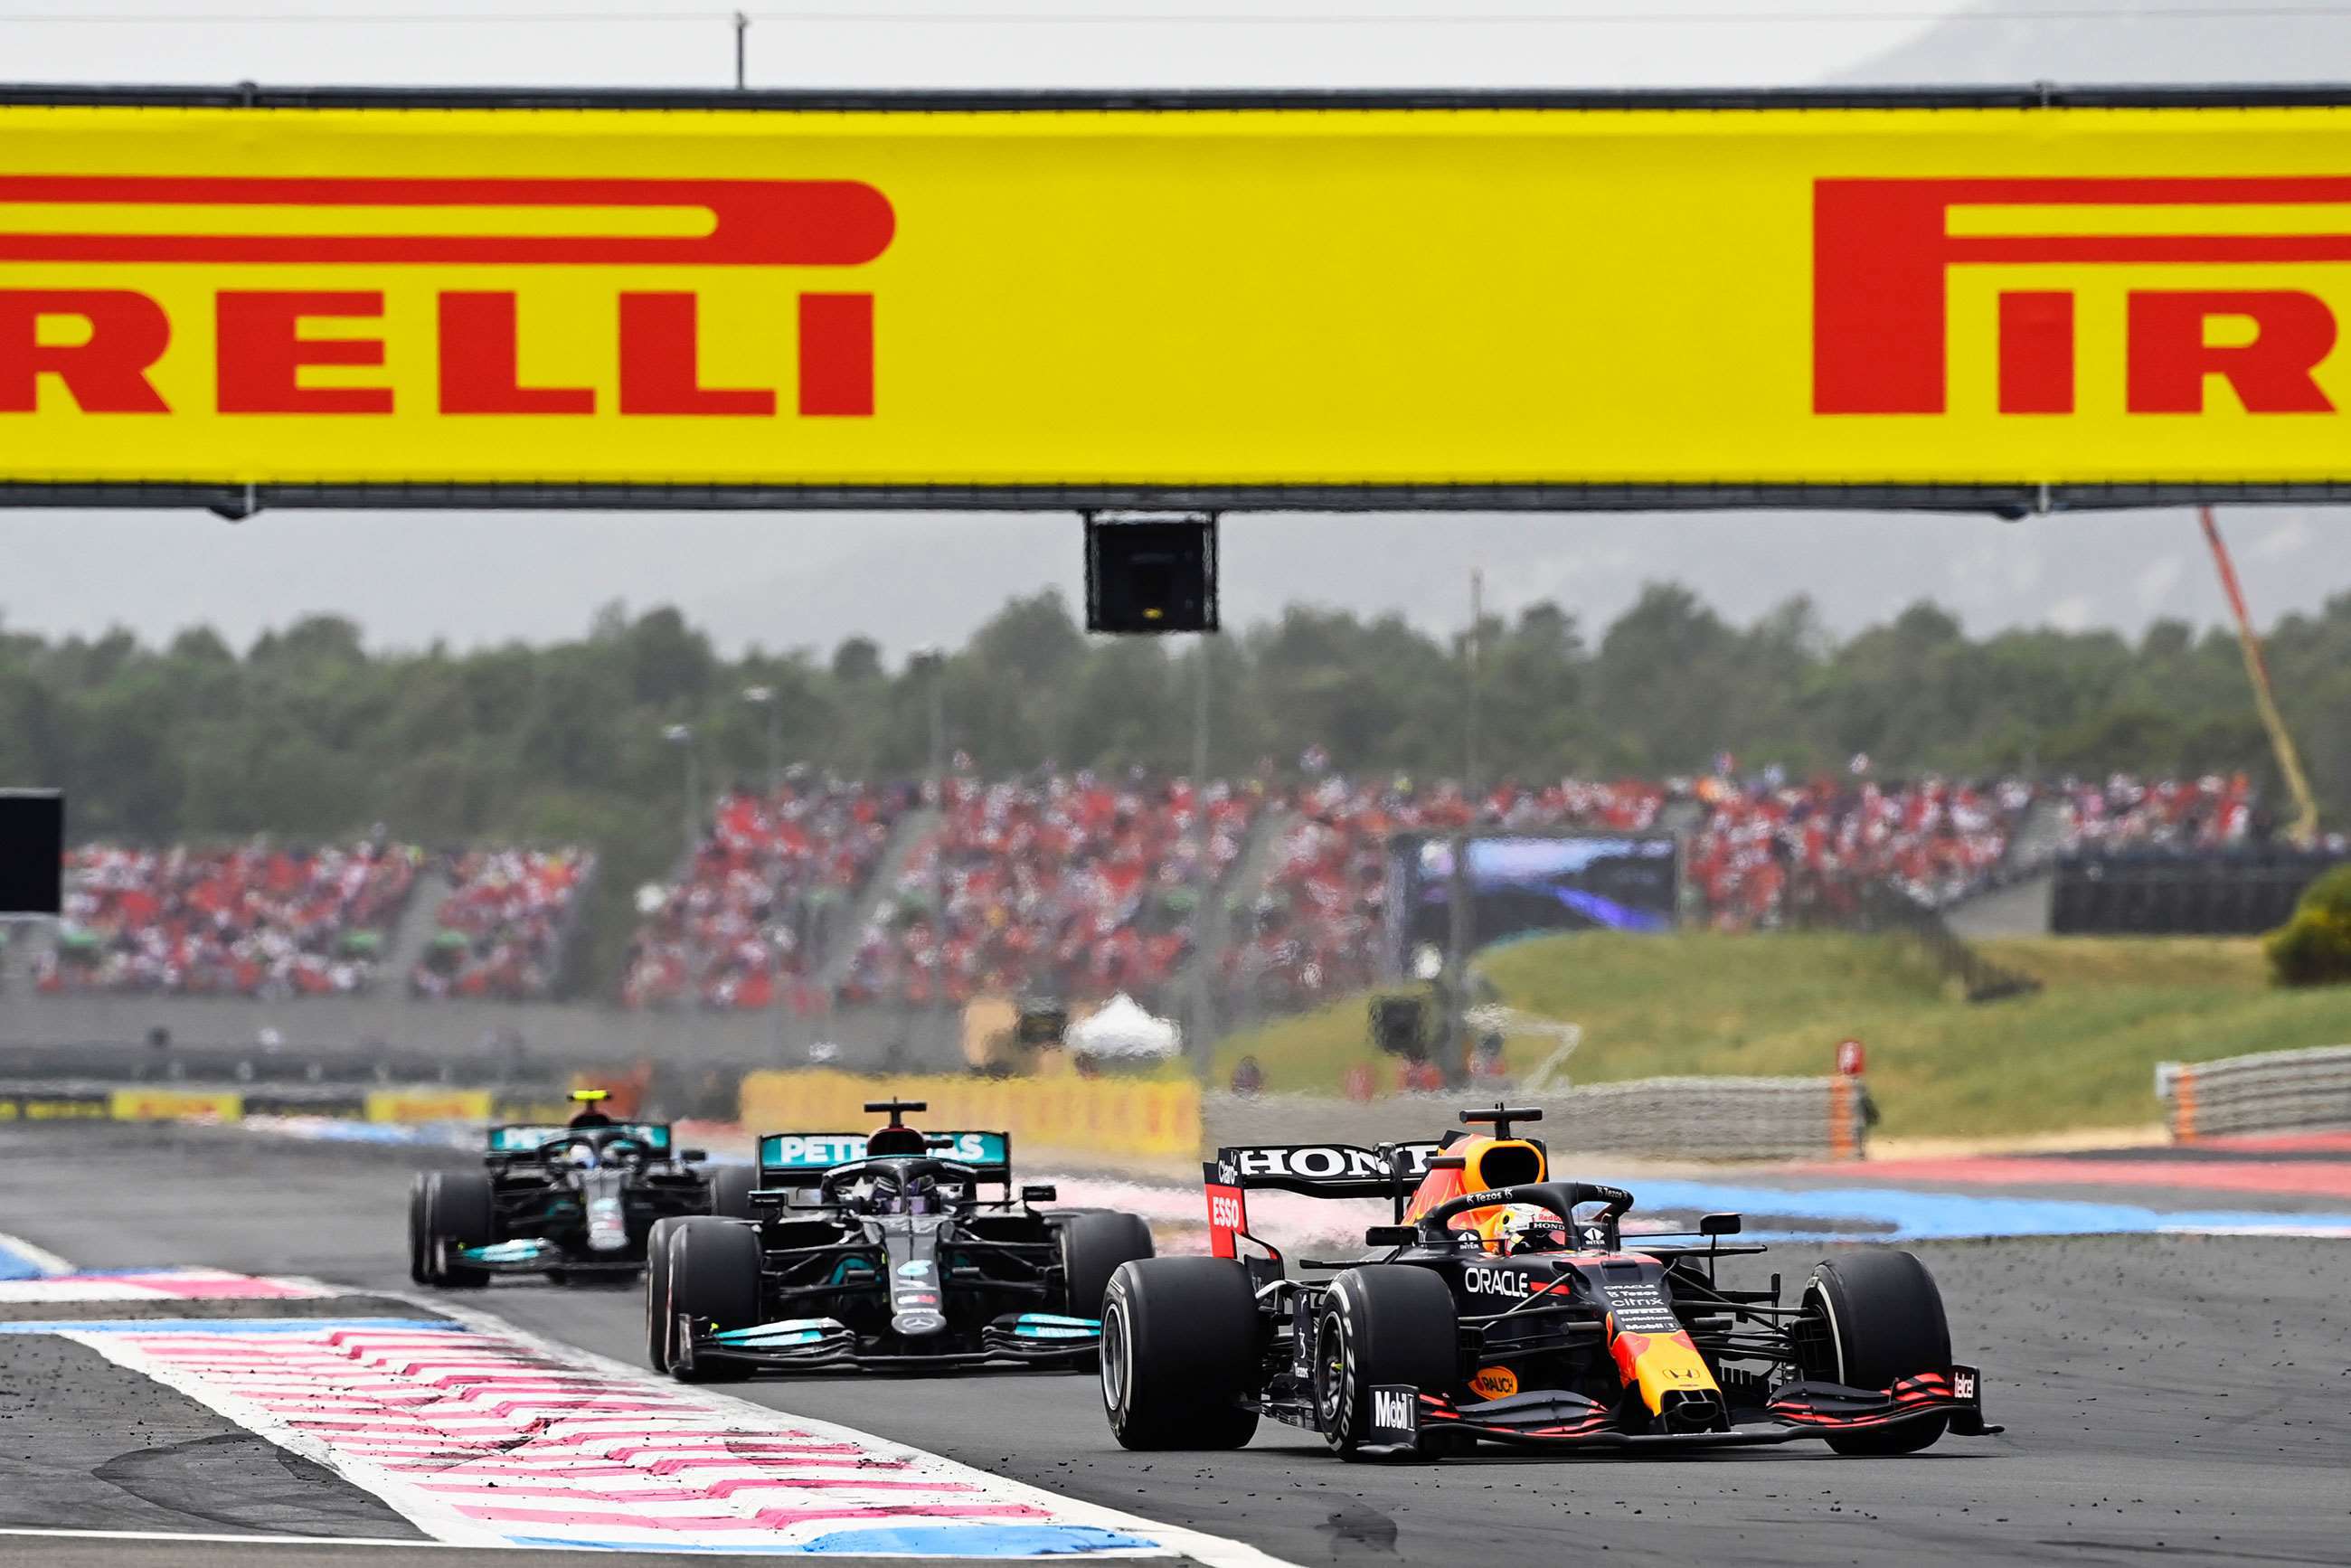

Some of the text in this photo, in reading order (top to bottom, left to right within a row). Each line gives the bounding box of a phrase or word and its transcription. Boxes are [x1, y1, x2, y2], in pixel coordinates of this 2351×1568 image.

[780, 1134, 984, 1163] PETRAS
[1213, 1195, 1240, 1229] ESSO
[1475, 1192, 1502, 1203] Tezos
[1465, 1267, 1529, 1298] ORACLE
[1625, 1322, 1665, 1330] Mobil
[1481, 1376, 1514, 1393] RAUCH
[1374, 1391, 1408, 1430] Mobil
